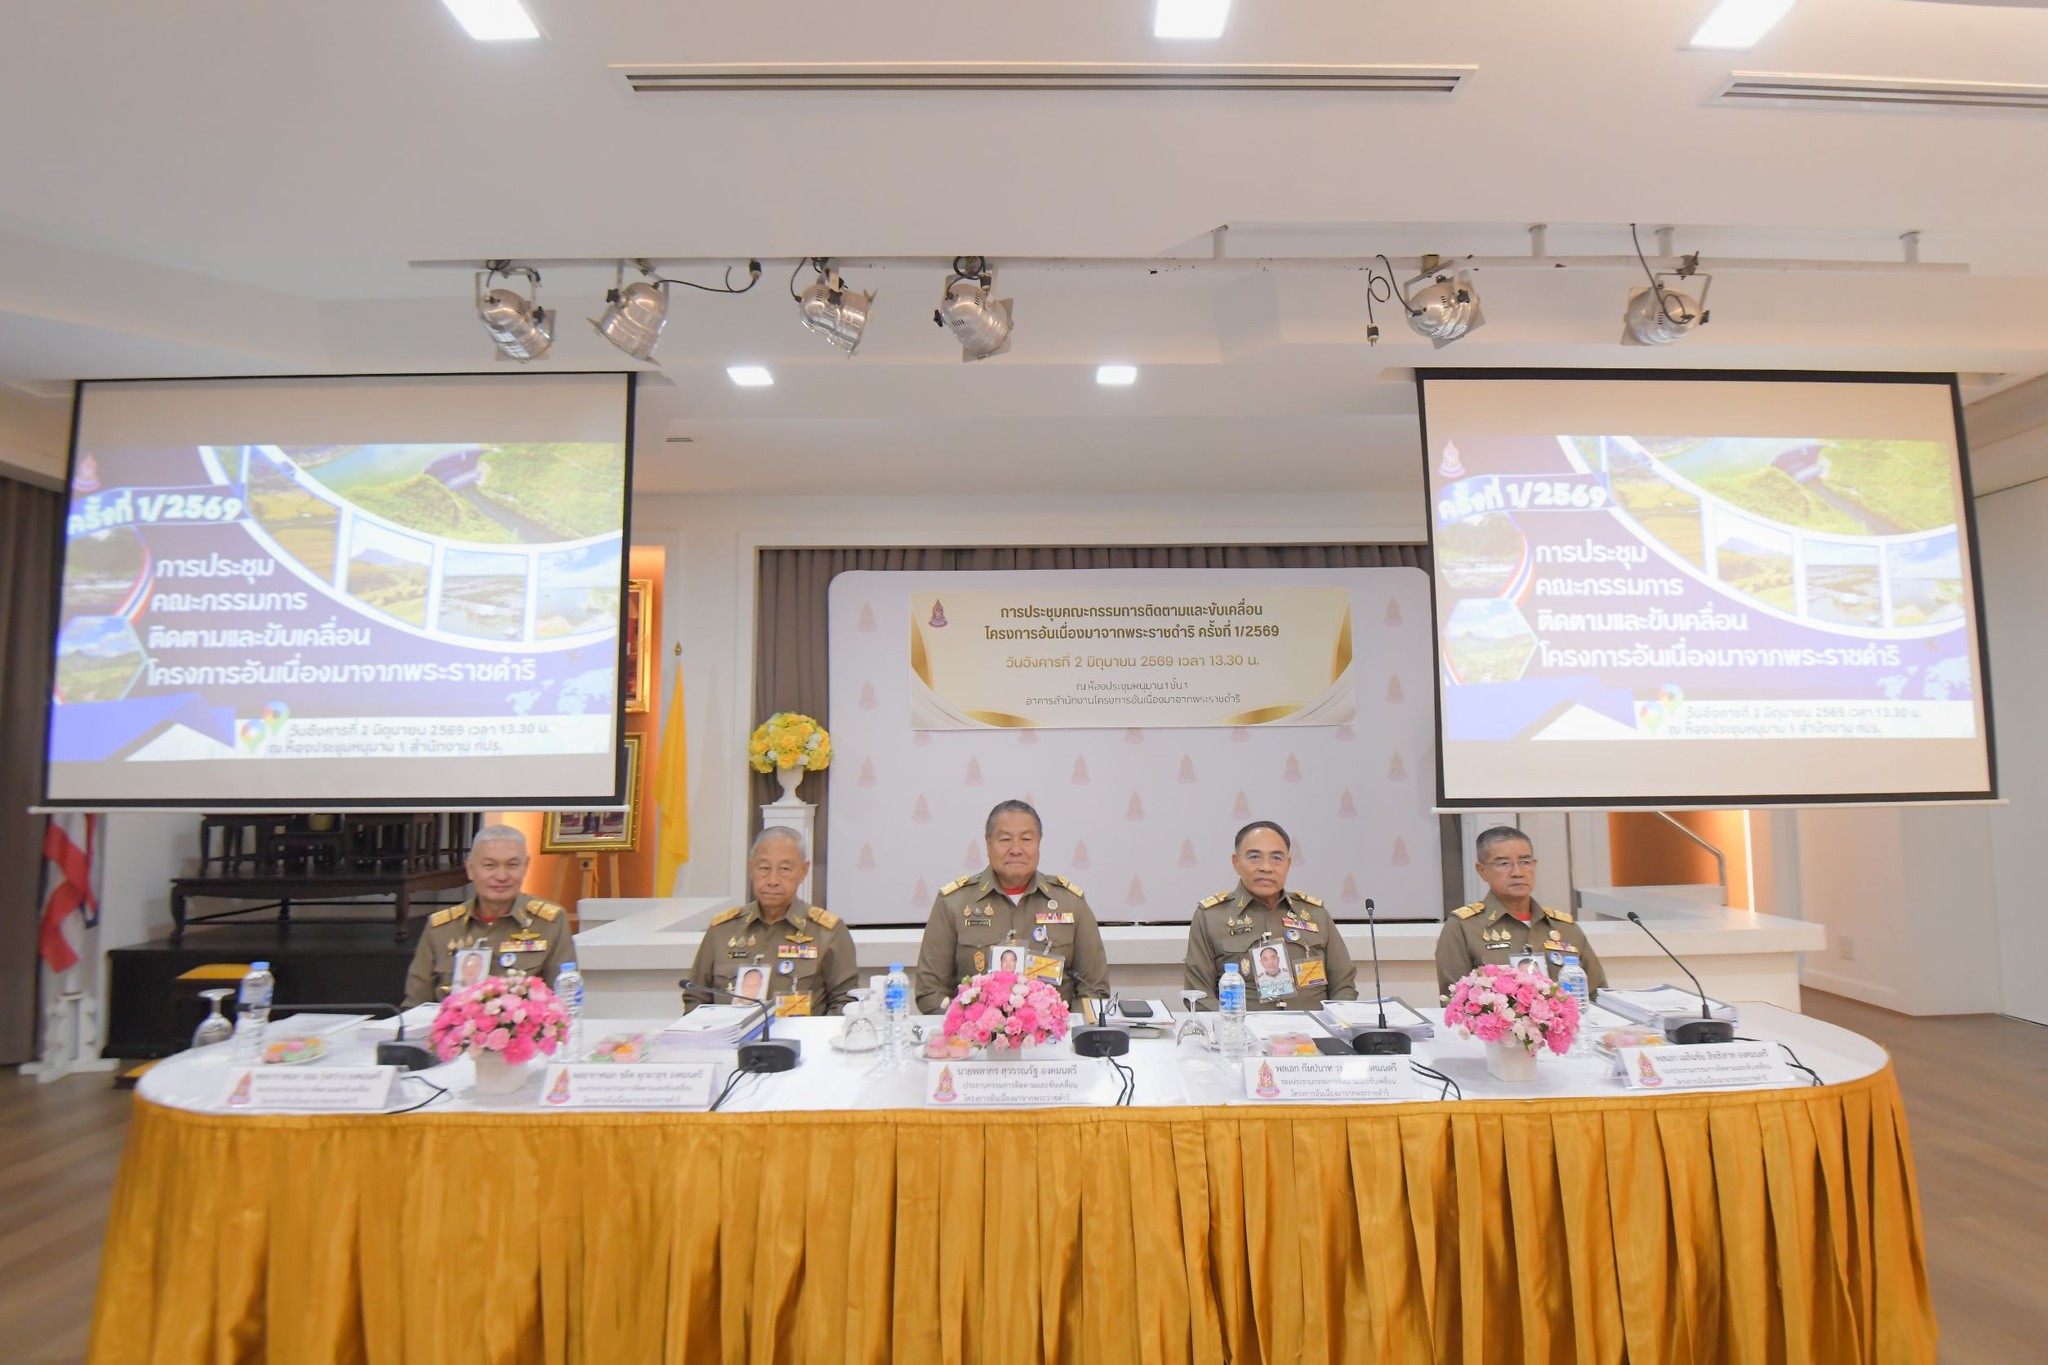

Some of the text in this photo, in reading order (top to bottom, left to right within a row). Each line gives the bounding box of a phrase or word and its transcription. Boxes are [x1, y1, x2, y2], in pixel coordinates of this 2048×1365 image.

[137, 494, 242, 521] 1/2569
[1506, 481, 1607, 508] 1/2569
[156, 553, 274, 584] การประชุม
[1535, 541, 1647, 571] การประชุม
[1535, 574, 1684, 597] คณะกรรมการ
[151, 589, 307, 612] คณะกรรมการ
[1000, 598, 1263, 621] การประชุมคณะกรรมการติดตามและขับเคลื่อน
[984, 620, 1279, 640] โครงการอันเนื่องมาจากพระราชดำริ ครั้งที่ 1/2569
[1537, 603, 1748, 633] ติดตามและขับเคลื่อน
[148, 616, 371, 649] ติดตามและขับเคลื่อน
[1006, 653, 1260, 671] วันอังคารที่ 2 มิถุนายน 2569 เวลา 13.30 น.
[1538, 640, 1901, 669] โครงการอันเนื่องมาจากพระราชดำริ
[146, 654, 537, 687] โครงการอันเนื่องมาจากพระราชดำริ
[430, 725, 464, 736] 2569
[501, 723, 535, 735] 13.30
